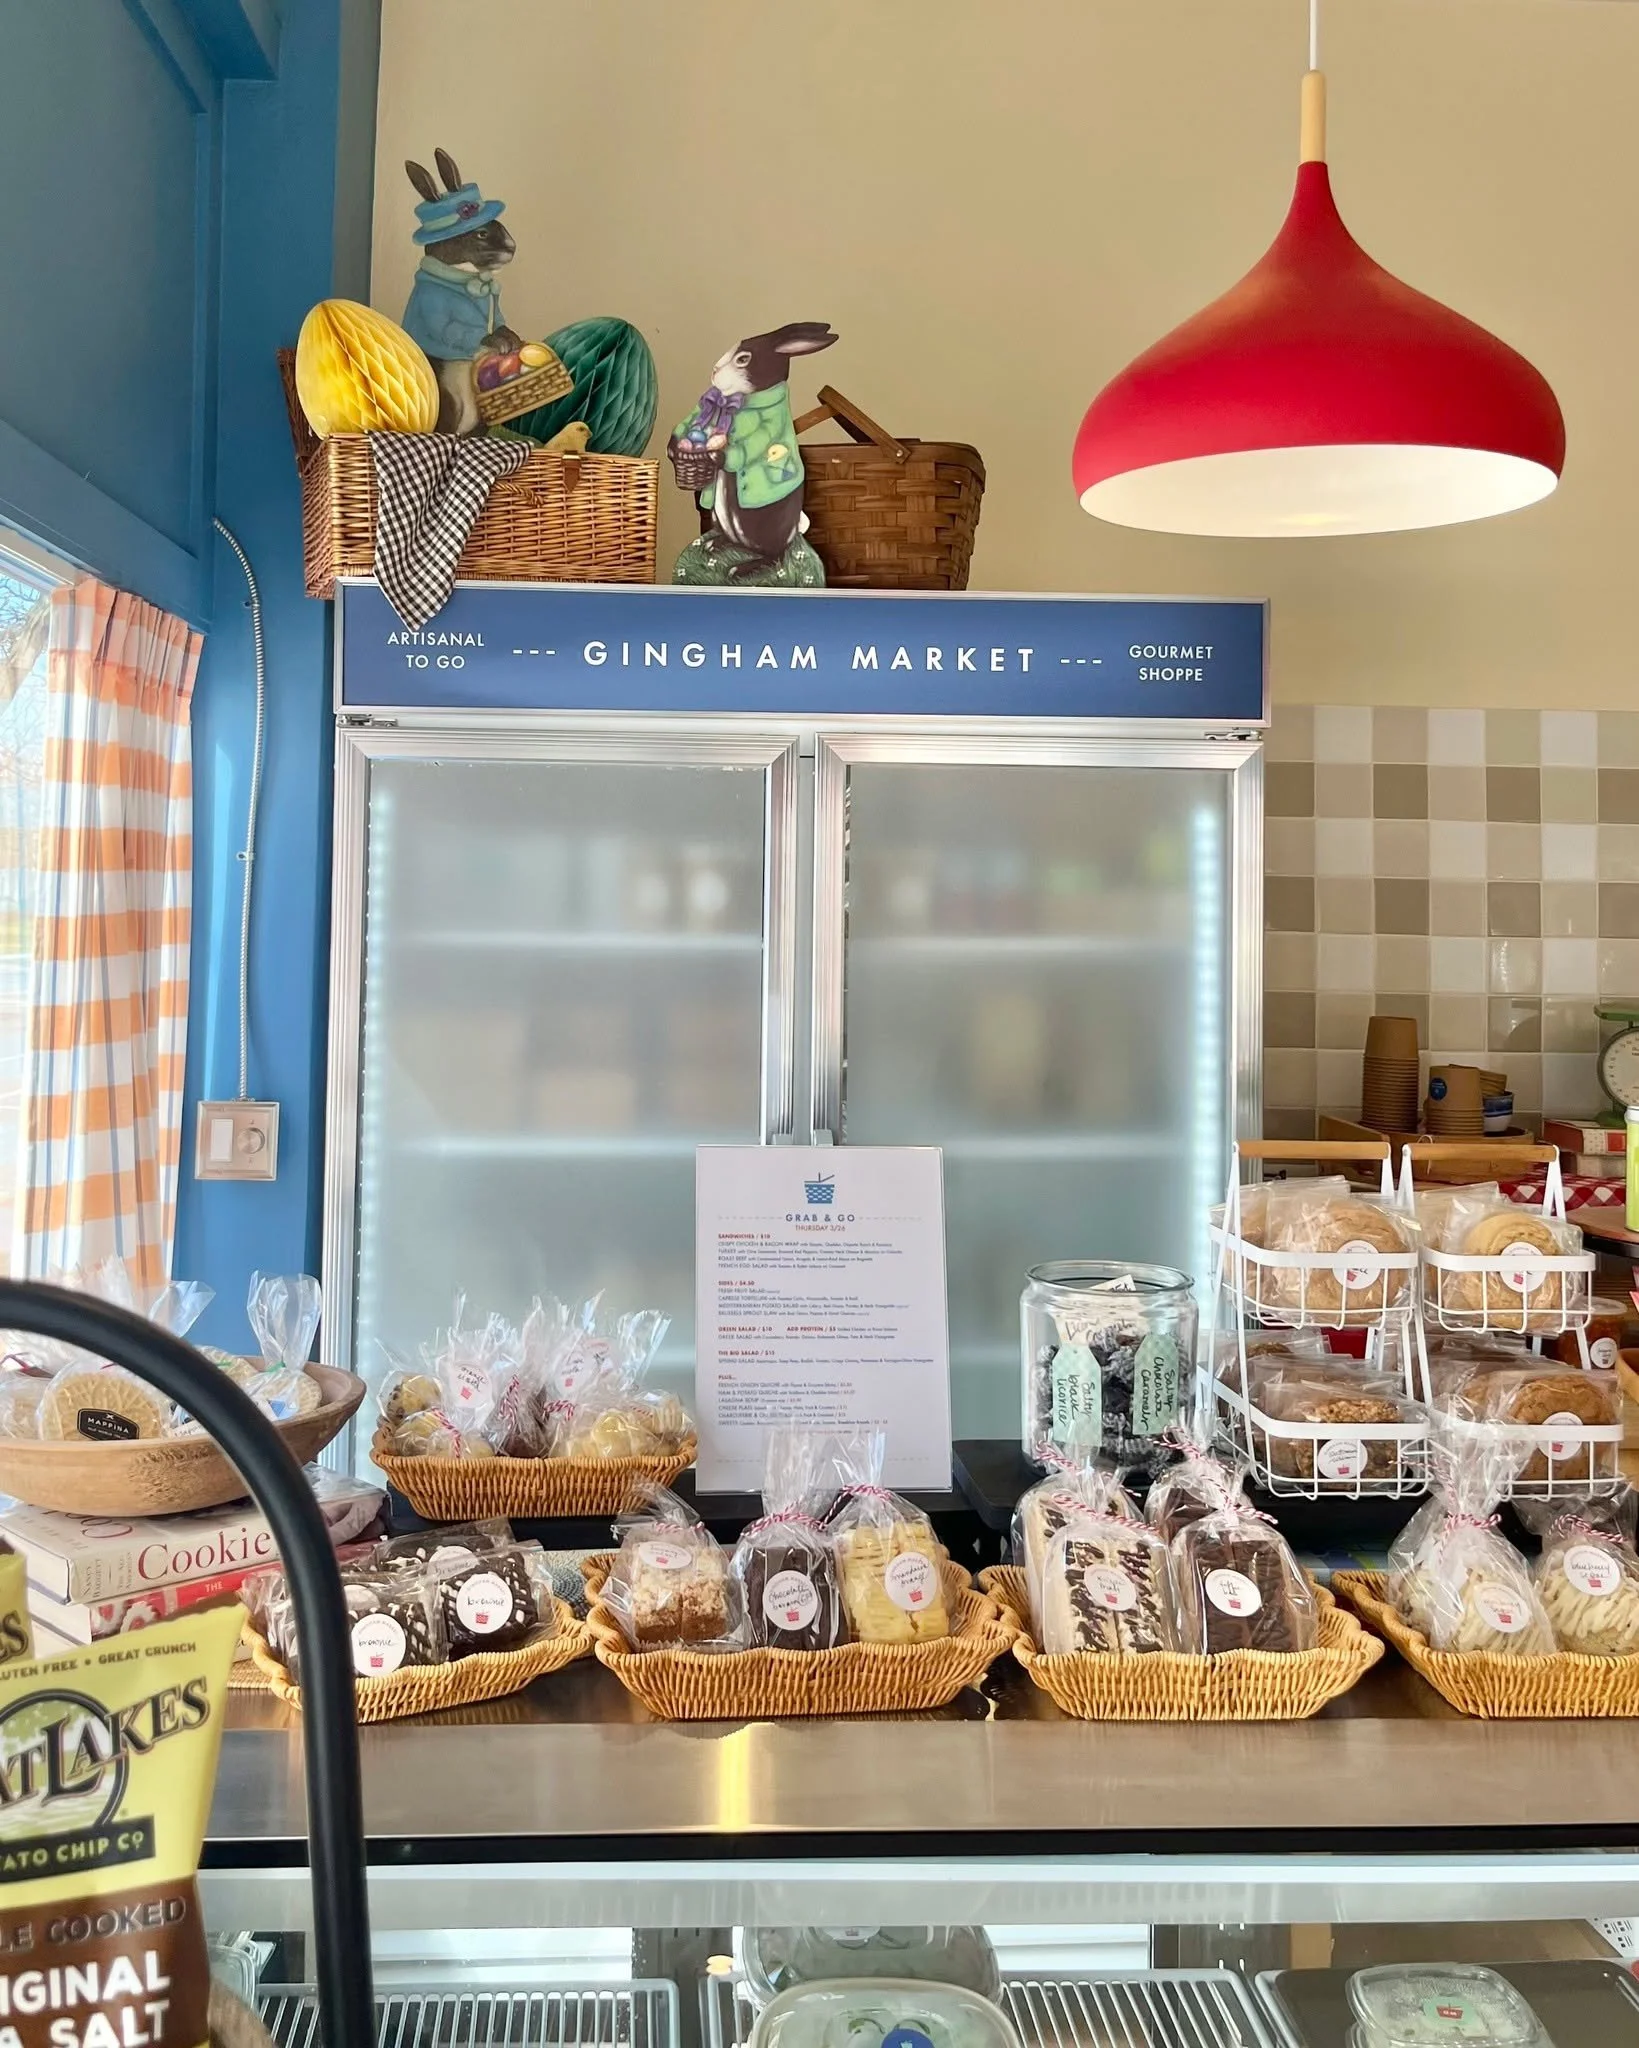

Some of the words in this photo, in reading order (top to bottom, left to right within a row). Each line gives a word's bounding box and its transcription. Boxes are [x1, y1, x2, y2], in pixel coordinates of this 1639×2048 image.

[387, 632, 485, 647] ARTISANAL
[584, 641, 818, 669] GINGHAM
[851, 646, 1035, 673] MARKET
[1129, 645, 1214, 659] GOURMET
[406, 655, 429, 668] TO
[437, 656, 465, 669] GO
[1139, 667, 1204, 681] SHOPPE
[785, 1213, 818, 1222] GRAB
[824, 1213, 831, 1222] &
[837, 1213, 855, 1222] GO
[87, 1417, 130, 1434] MAPPINA
[205, 1581, 224, 1593] THE
[98, 1649, 141, 1667] GREAT
[145, 1641, 198, 1660] CRUNCH
[43, 1659, 79, 1677] FREE
[56, 1837, 111, 1864] CHIP
[46, 1895, 187, 1948] COOKED
